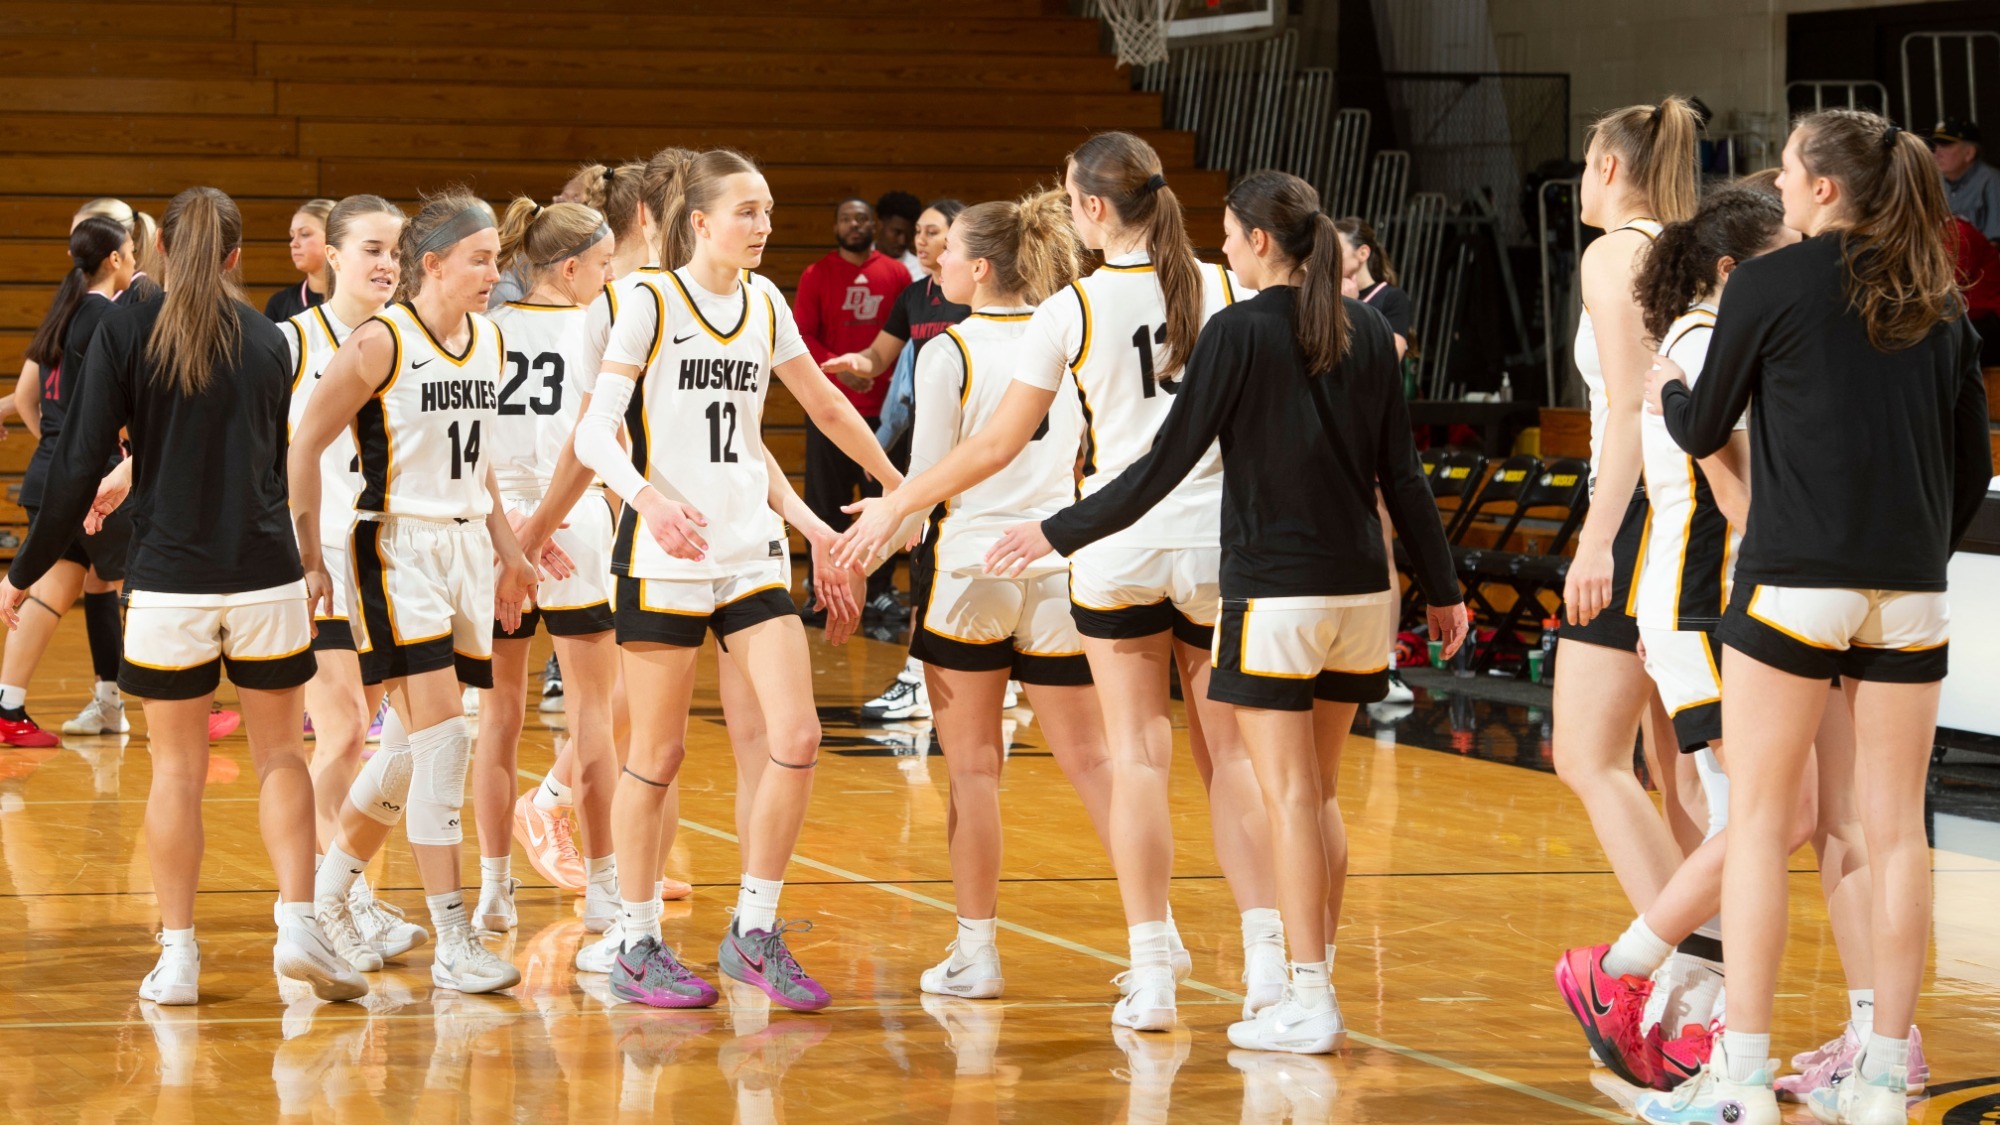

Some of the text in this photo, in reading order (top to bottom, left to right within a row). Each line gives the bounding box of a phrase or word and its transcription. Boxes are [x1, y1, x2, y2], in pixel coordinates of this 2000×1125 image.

[842, 286, 884, 320] DU
[421, 379, 497, 412] HUSKIES
[498, 350, 565, 415] 23
[678, 358, 759, 393] HUSKIES
[447, 420, 481, 480] 14
[705, 401, 738, 463] 12
